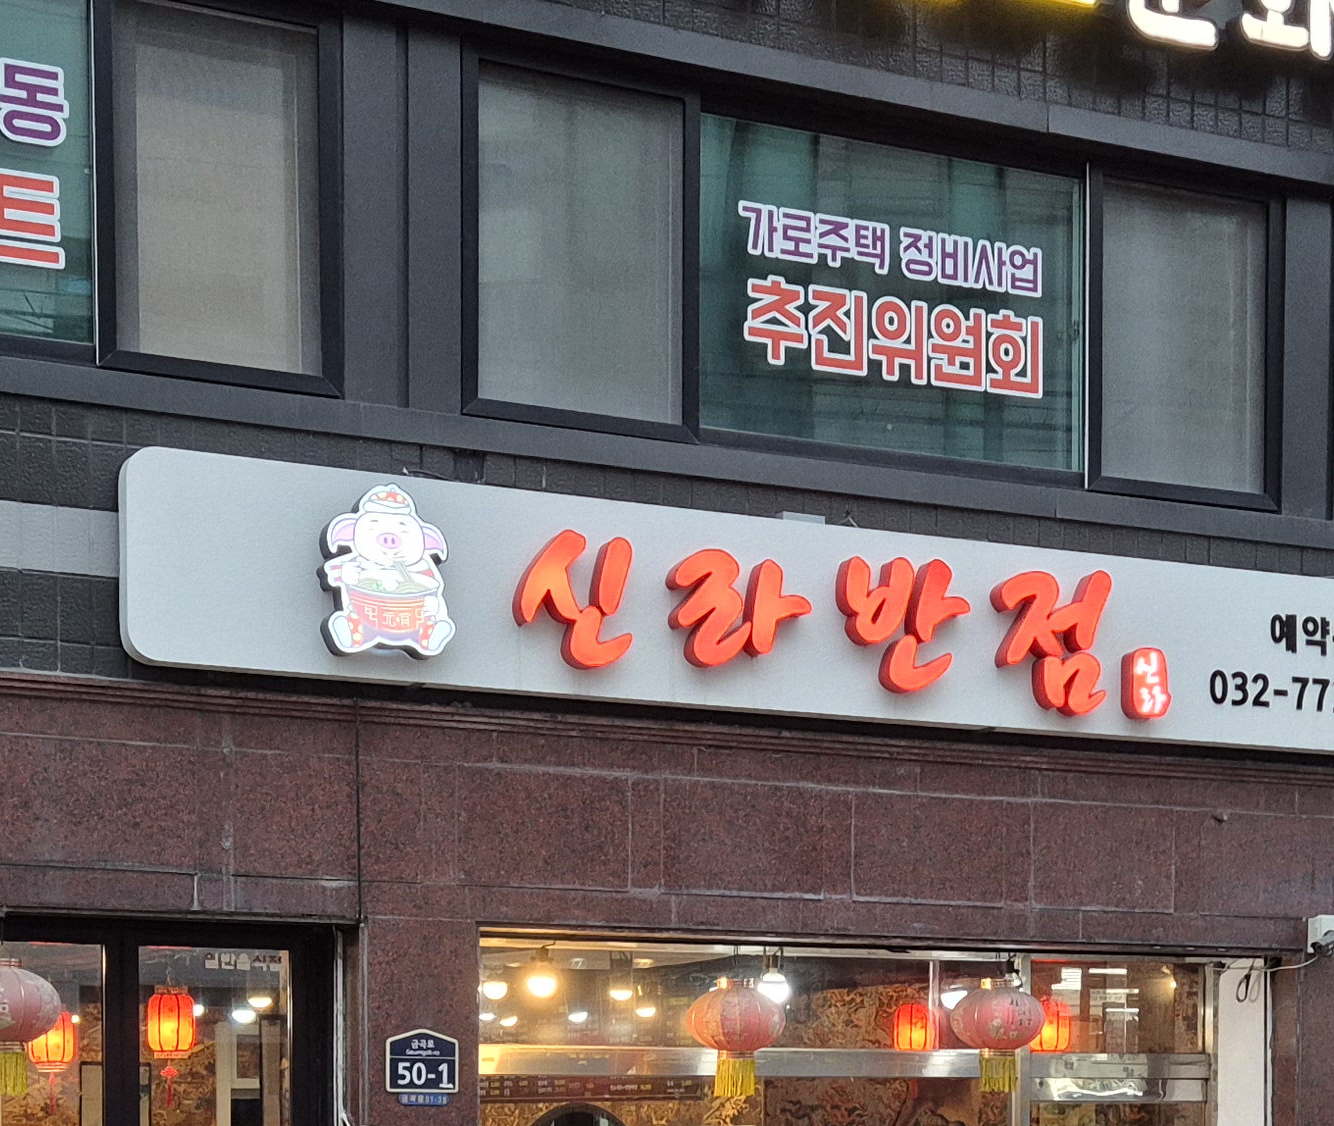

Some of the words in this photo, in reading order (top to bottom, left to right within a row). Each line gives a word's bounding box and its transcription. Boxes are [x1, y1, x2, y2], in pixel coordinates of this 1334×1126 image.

[738, 201, 890, 275] 가로주택
[900, 226, 1043, 298] 정비사업
[744, 275, 1043, 399] 추진위원회
[512, 529, 1112, 716] 신라반점
[397, 1061, 454, 1089] 50-1
